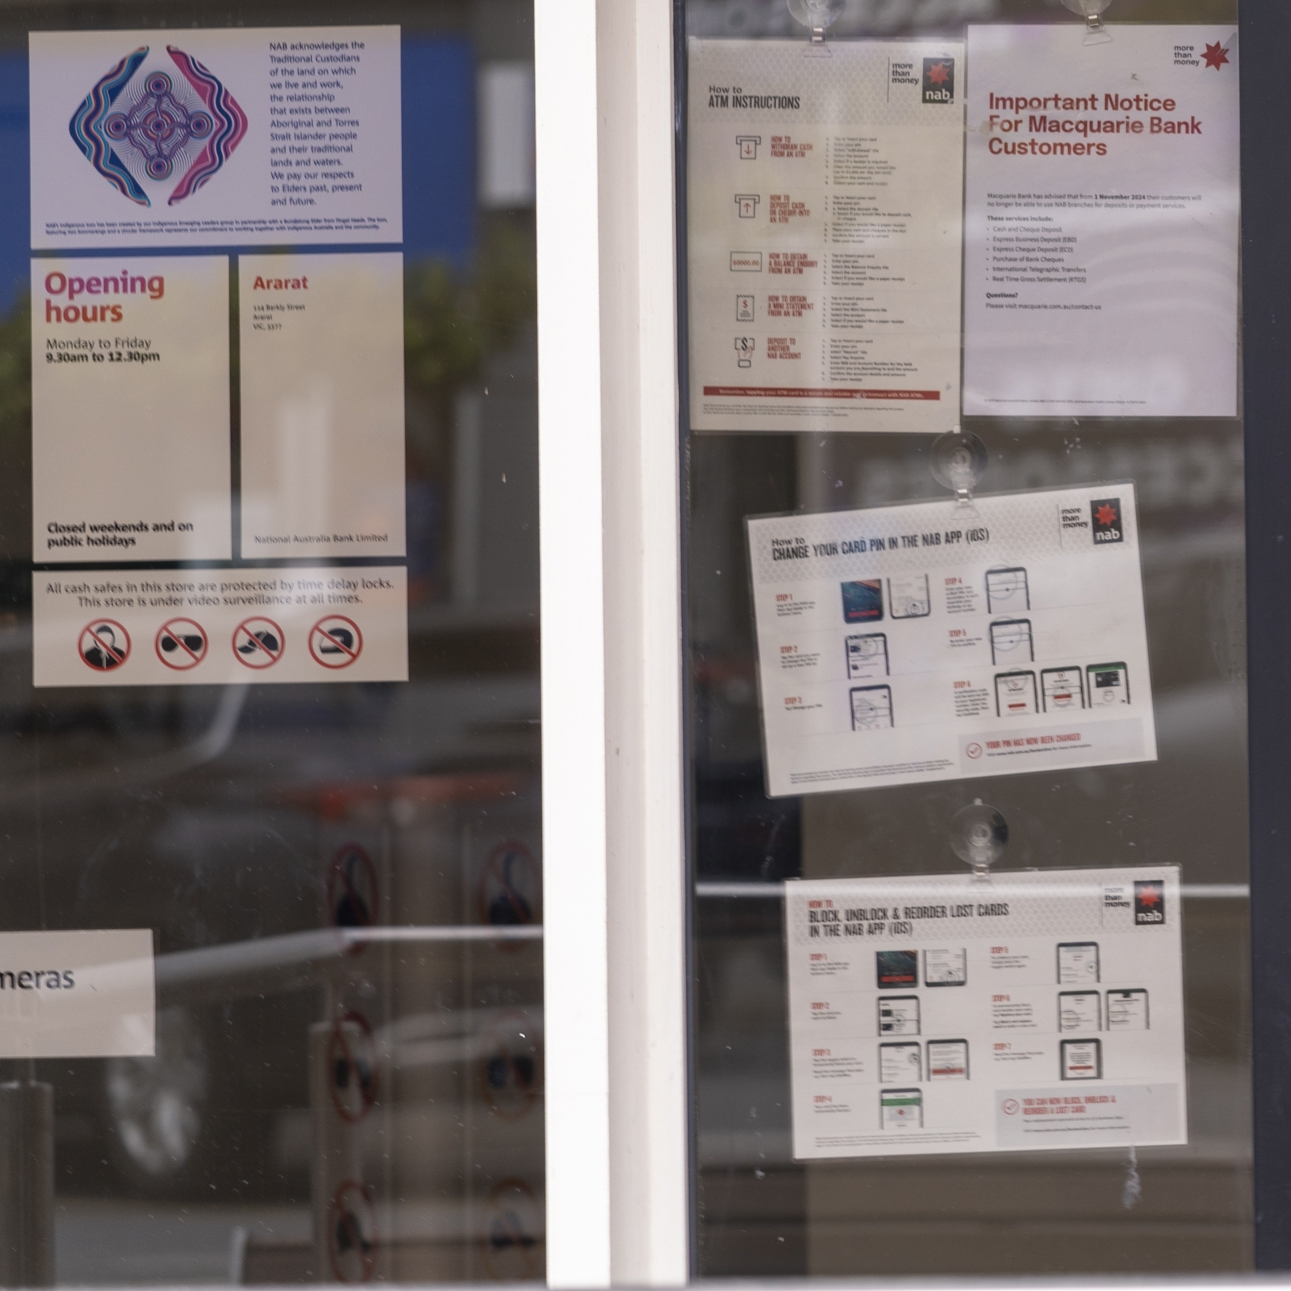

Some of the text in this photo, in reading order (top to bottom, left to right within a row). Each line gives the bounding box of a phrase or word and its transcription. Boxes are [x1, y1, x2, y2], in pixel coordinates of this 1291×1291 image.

[269, 40, 364, 50] NAB acknowledges the
[269, 53, 360, 63] Traditional Custodians
[269, 67, 278, 76] of
[281, 67, 294, 76] the
[297, 67, 315, 76] land
[331, 66, 356, 75] which
[892, 63, 913, 72] more
[284, 80, 299, 89] live
[301, 80, 317, 88] and
[319, 80, 343, 88] work,
[709, 85, 729, 93] How
[270, 93, 335, 102] the relationship
[926, 88, 951, 101] nab
[708, 94, 800, 109] ATM INSTRUCTIONS
[989, 93, 1175, 114] Important Notice
[270, 106, 286, 115] that
[314, 106, 350, 114] between
[270, 118, 359, 129] Aboriginal and Torres
[988, 114, 1201, 136] For Macquarie Bank
[270, 132, 357, 141] Strait Islander people
[270, 144, 353, 154] and their traditional
[988, 138, 1106, 155] Customers
[270, 158, 292, 167] lands
[295, 158, 310, 166] and
[270, 171, 284, 179] We
[287, 172, 301, 181] pay
[282, 184, 306, 192] Elders
[309, 184, 328, 193] past,
[270, 196, 316, 205] and future.
[44, 269, 164, 300] Opening
[253, 276, 308, 289] Ararat
[45, 298, 124, 324] hours
[46, 337, 151, 350] Monday to Friday
[46, 350, 160, 364] 9.30am to 12.30pm
[47, 520, 193, 533] Closed weekends and on
[1062, 521, 1088, 529] money
[254, 534, 388, 543] National Australia Bank Limited
[1095, 528, 1120, 542] nab
[47, 534, 136, 547] public holidays
[771, 536, 805, 546] How to
[772, 545, 809, 561] CHANGE
[841, 539, 866, 554] CARD
[869, 537, 885, 552] PIN
[888, 536, 898, 550] IN
[901, 534, 918, 548] THE
[921, 532, 941, 546] NAB
[944, 530, 962, 544] APP
[46, 578, 393, 593] All cash safes in this store are protected by time delay locks.
[78, 593, 362, 607] This store is under video surveillance at all times.
